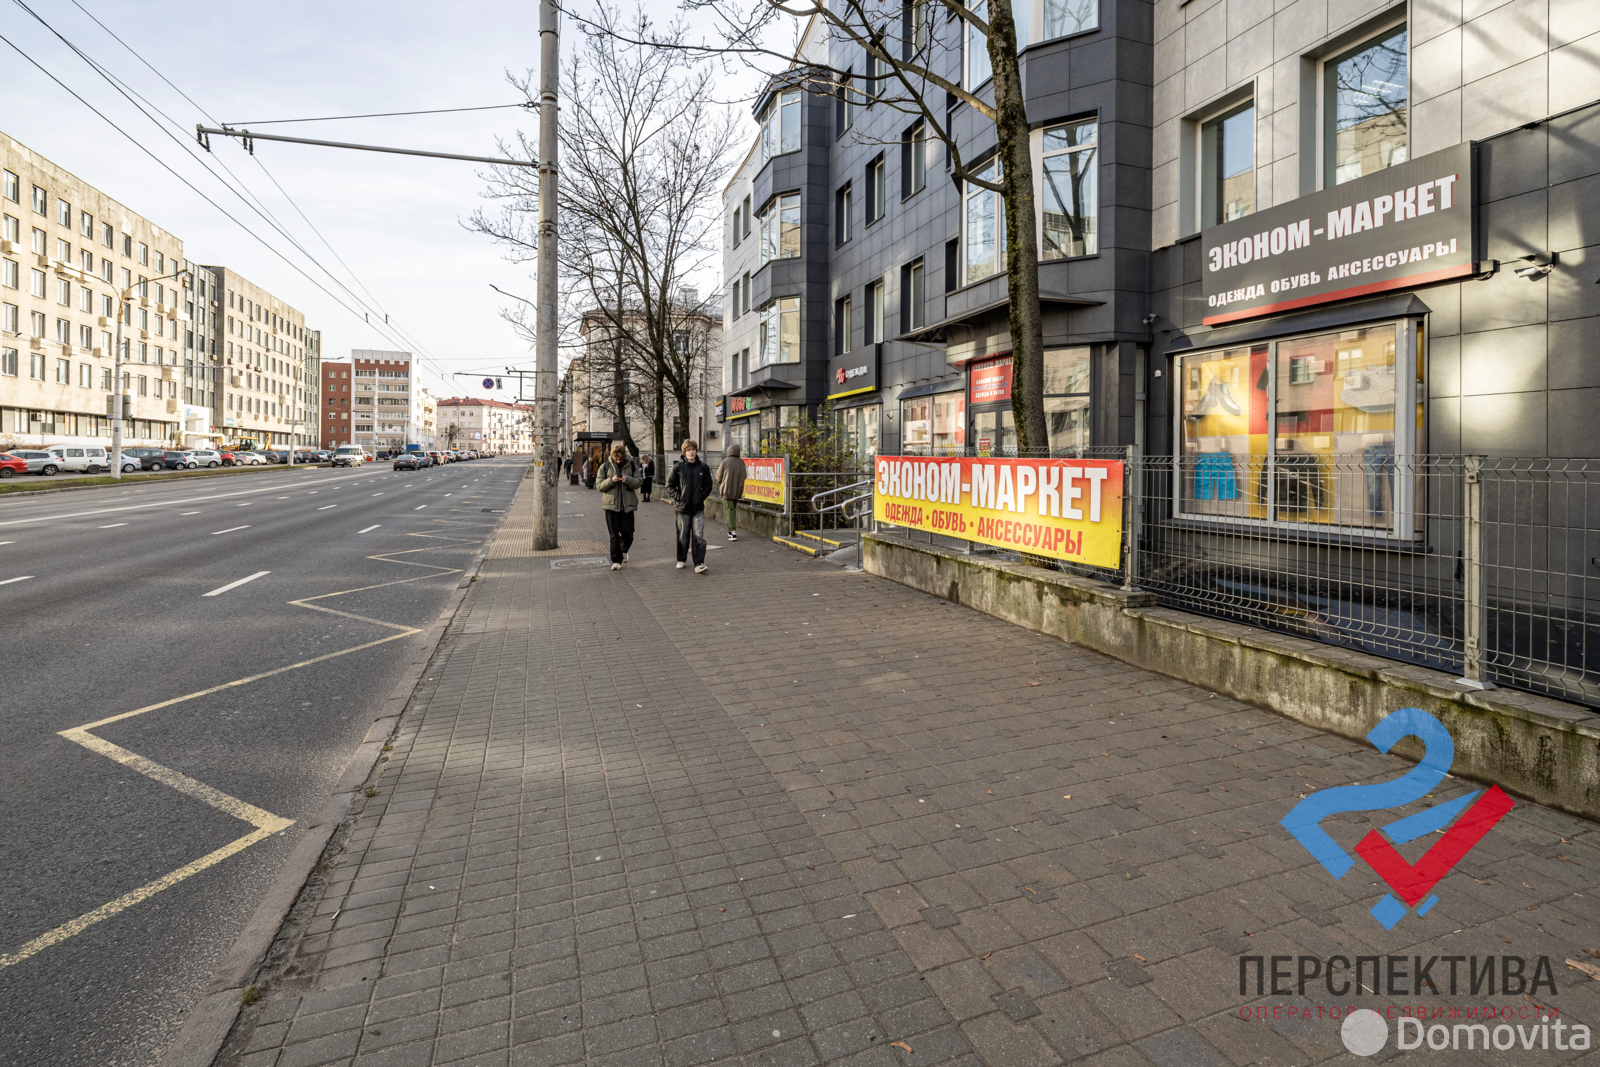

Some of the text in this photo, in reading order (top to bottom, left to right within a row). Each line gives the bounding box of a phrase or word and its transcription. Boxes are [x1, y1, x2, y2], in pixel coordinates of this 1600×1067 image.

[1208, 238, 1457, 307] ОДЕЖДА ОБУВЬ АКСЕССУАРЫ
[878, 461, 1108, 522] ЭКОНОМ-МАРКЕТ
[885, 502, 1083, 556] ОДЕЖДА ОБУВЬ АКСЕССУАРЫ
